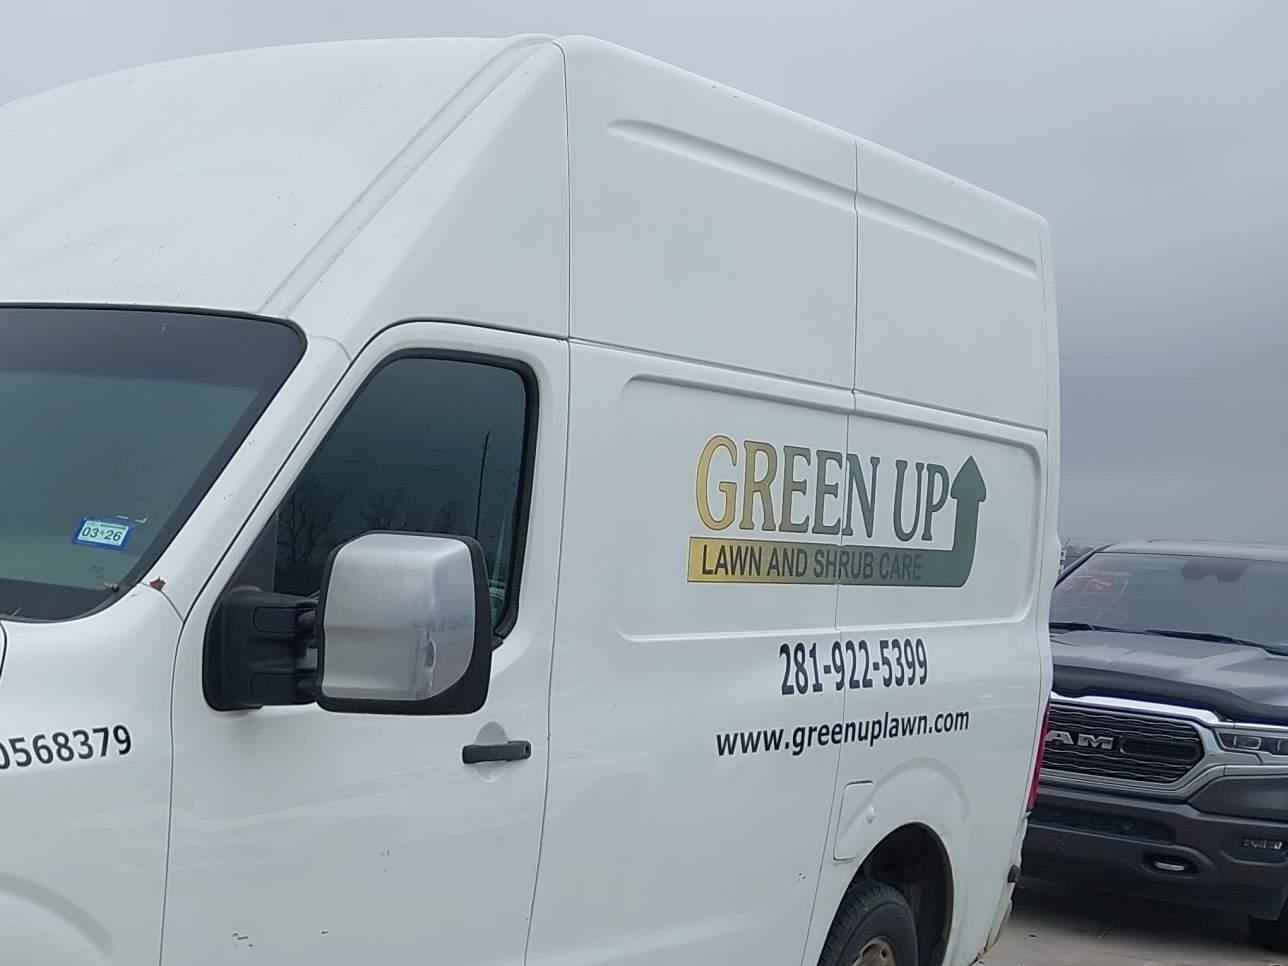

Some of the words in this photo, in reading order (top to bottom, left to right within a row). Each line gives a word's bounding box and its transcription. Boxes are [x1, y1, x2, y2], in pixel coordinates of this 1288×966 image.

[696, 435, 880, 538] GREEN
[893, 459, 950, 542] UP
[81, 526, 100, 538] 03
[103, 529, 123, 542] 26
[701, 544, 762, 577] LAWN
[766, 547, 808, 577] AND
[812, 549, 873, 580] SHRUB
[879, 552, 922, 581] CARE
[779, 638, 928, 695] 281-922-5399
[716, 711, 970, 756] www.greenuplawn.com
[1045, 730, 1114, 750] AM
